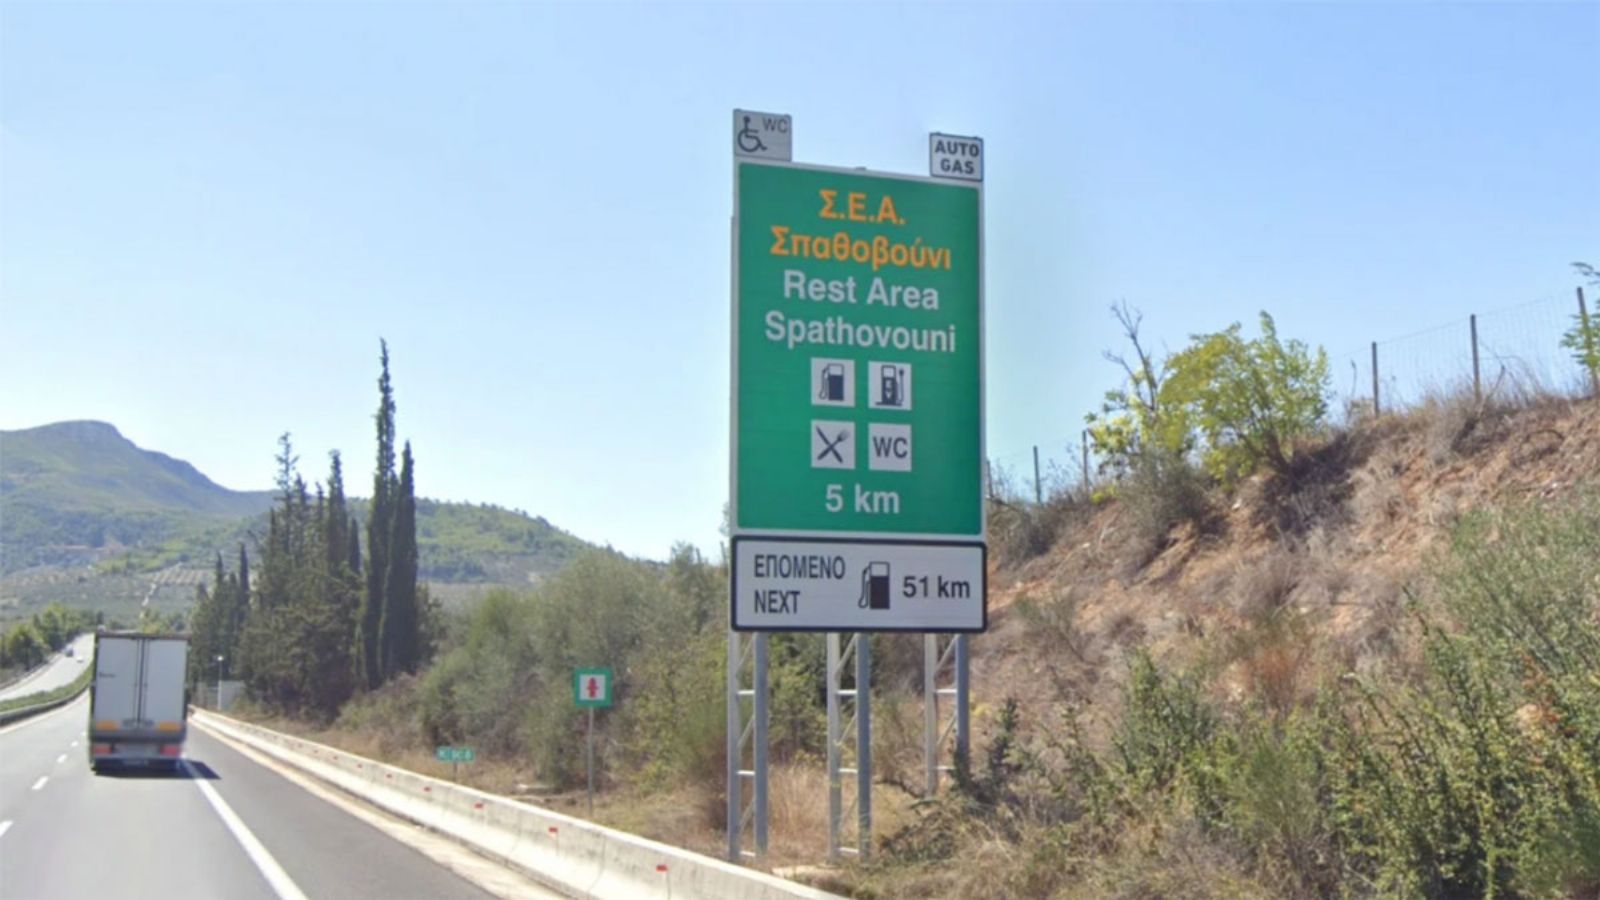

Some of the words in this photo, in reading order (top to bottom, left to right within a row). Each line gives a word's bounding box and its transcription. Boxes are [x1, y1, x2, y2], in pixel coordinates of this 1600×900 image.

[762, 117, 789, 134] WC
[934, 141, 980, 158] AUTO
[940, 158, 975, 175] GAS
[770, 226, 951, 271] Σπαθοβούνι
[783, 269, 857, 304] Rest
[866, 277, 940, 311] Area
[765, 310, 955, 352] Spathovouni
[872, 437, 909, 459] WC
[825, 484, 844, 513] 5
[854, 483, 900, 514] km
[753, 553, 846, 580] ΕΠΟΜΕΝΟ
[902, 576, 930, 598] 51
[937, 576, 971, 600] km
[753, 590, 801, 615] NEXT
